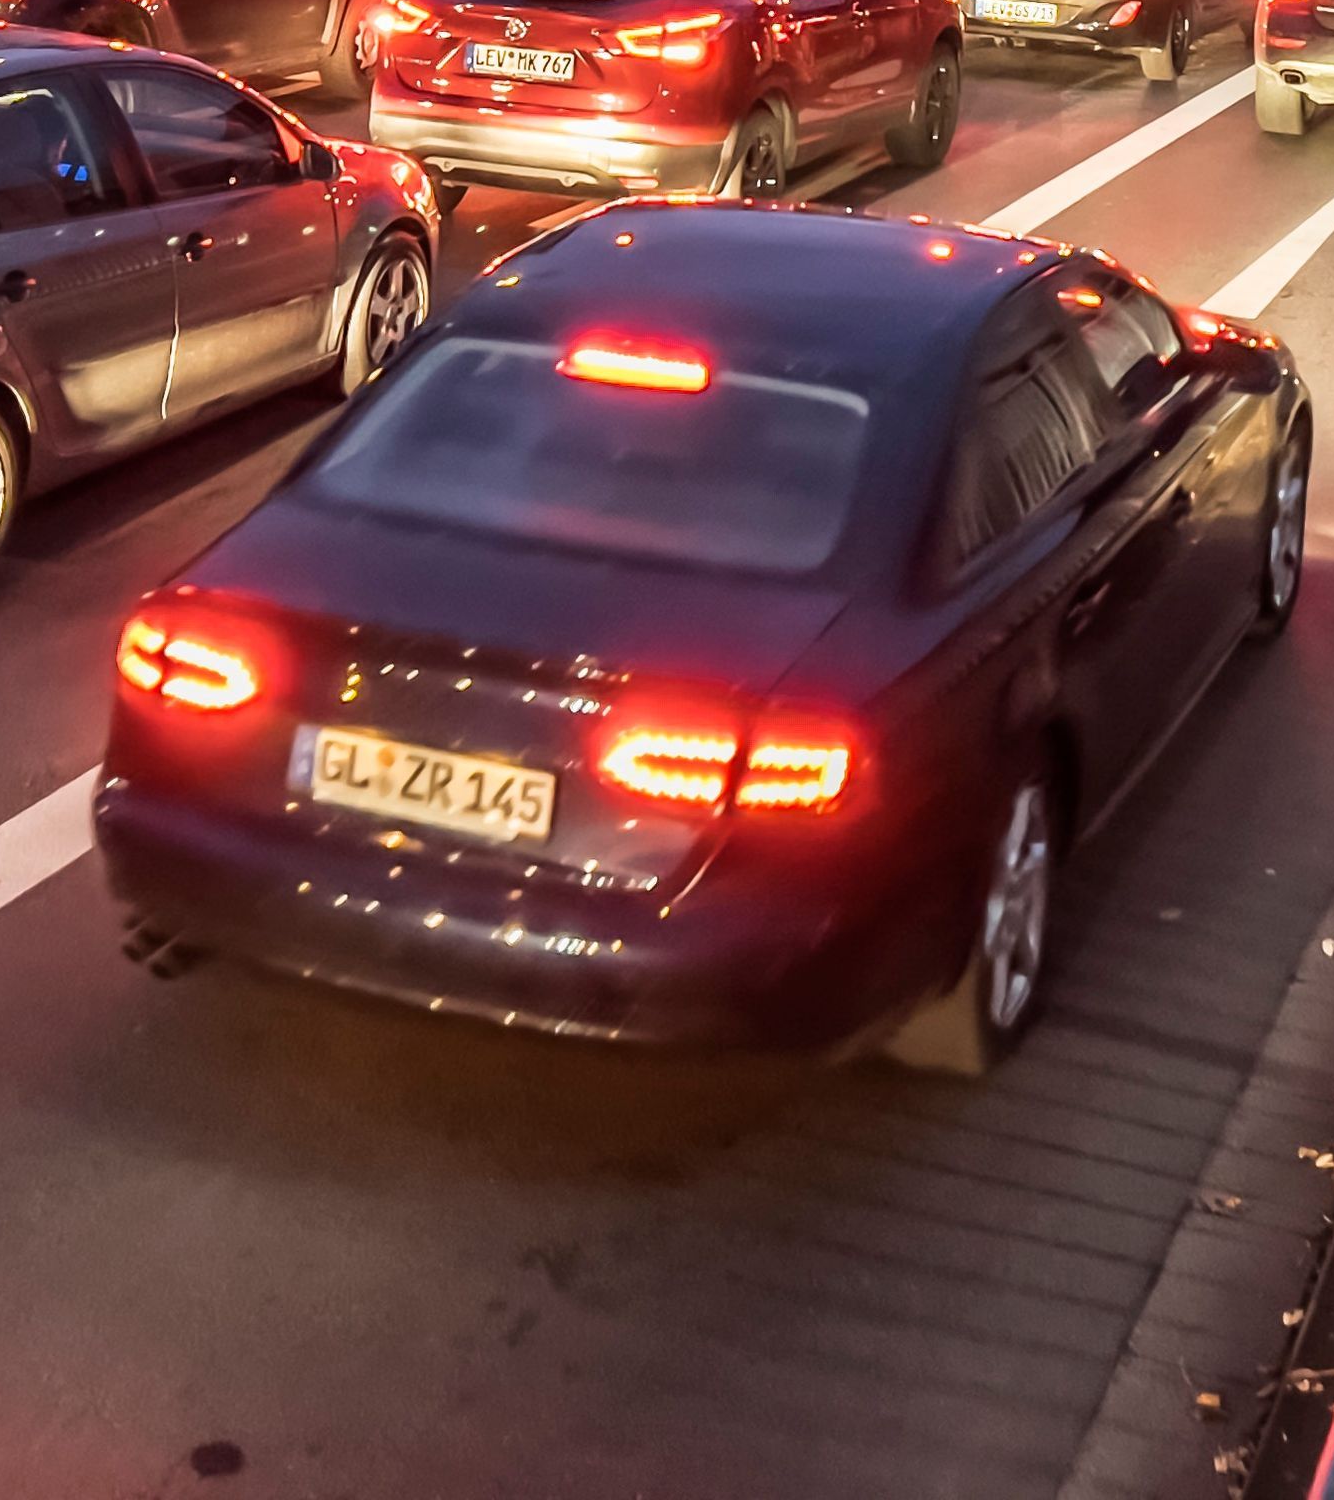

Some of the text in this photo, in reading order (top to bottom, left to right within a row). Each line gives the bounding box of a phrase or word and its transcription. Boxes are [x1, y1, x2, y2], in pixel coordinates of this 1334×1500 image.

[476, 47, 573, 75] LEV MK 767
[320, 740, 547, 824] GL ZR 145
